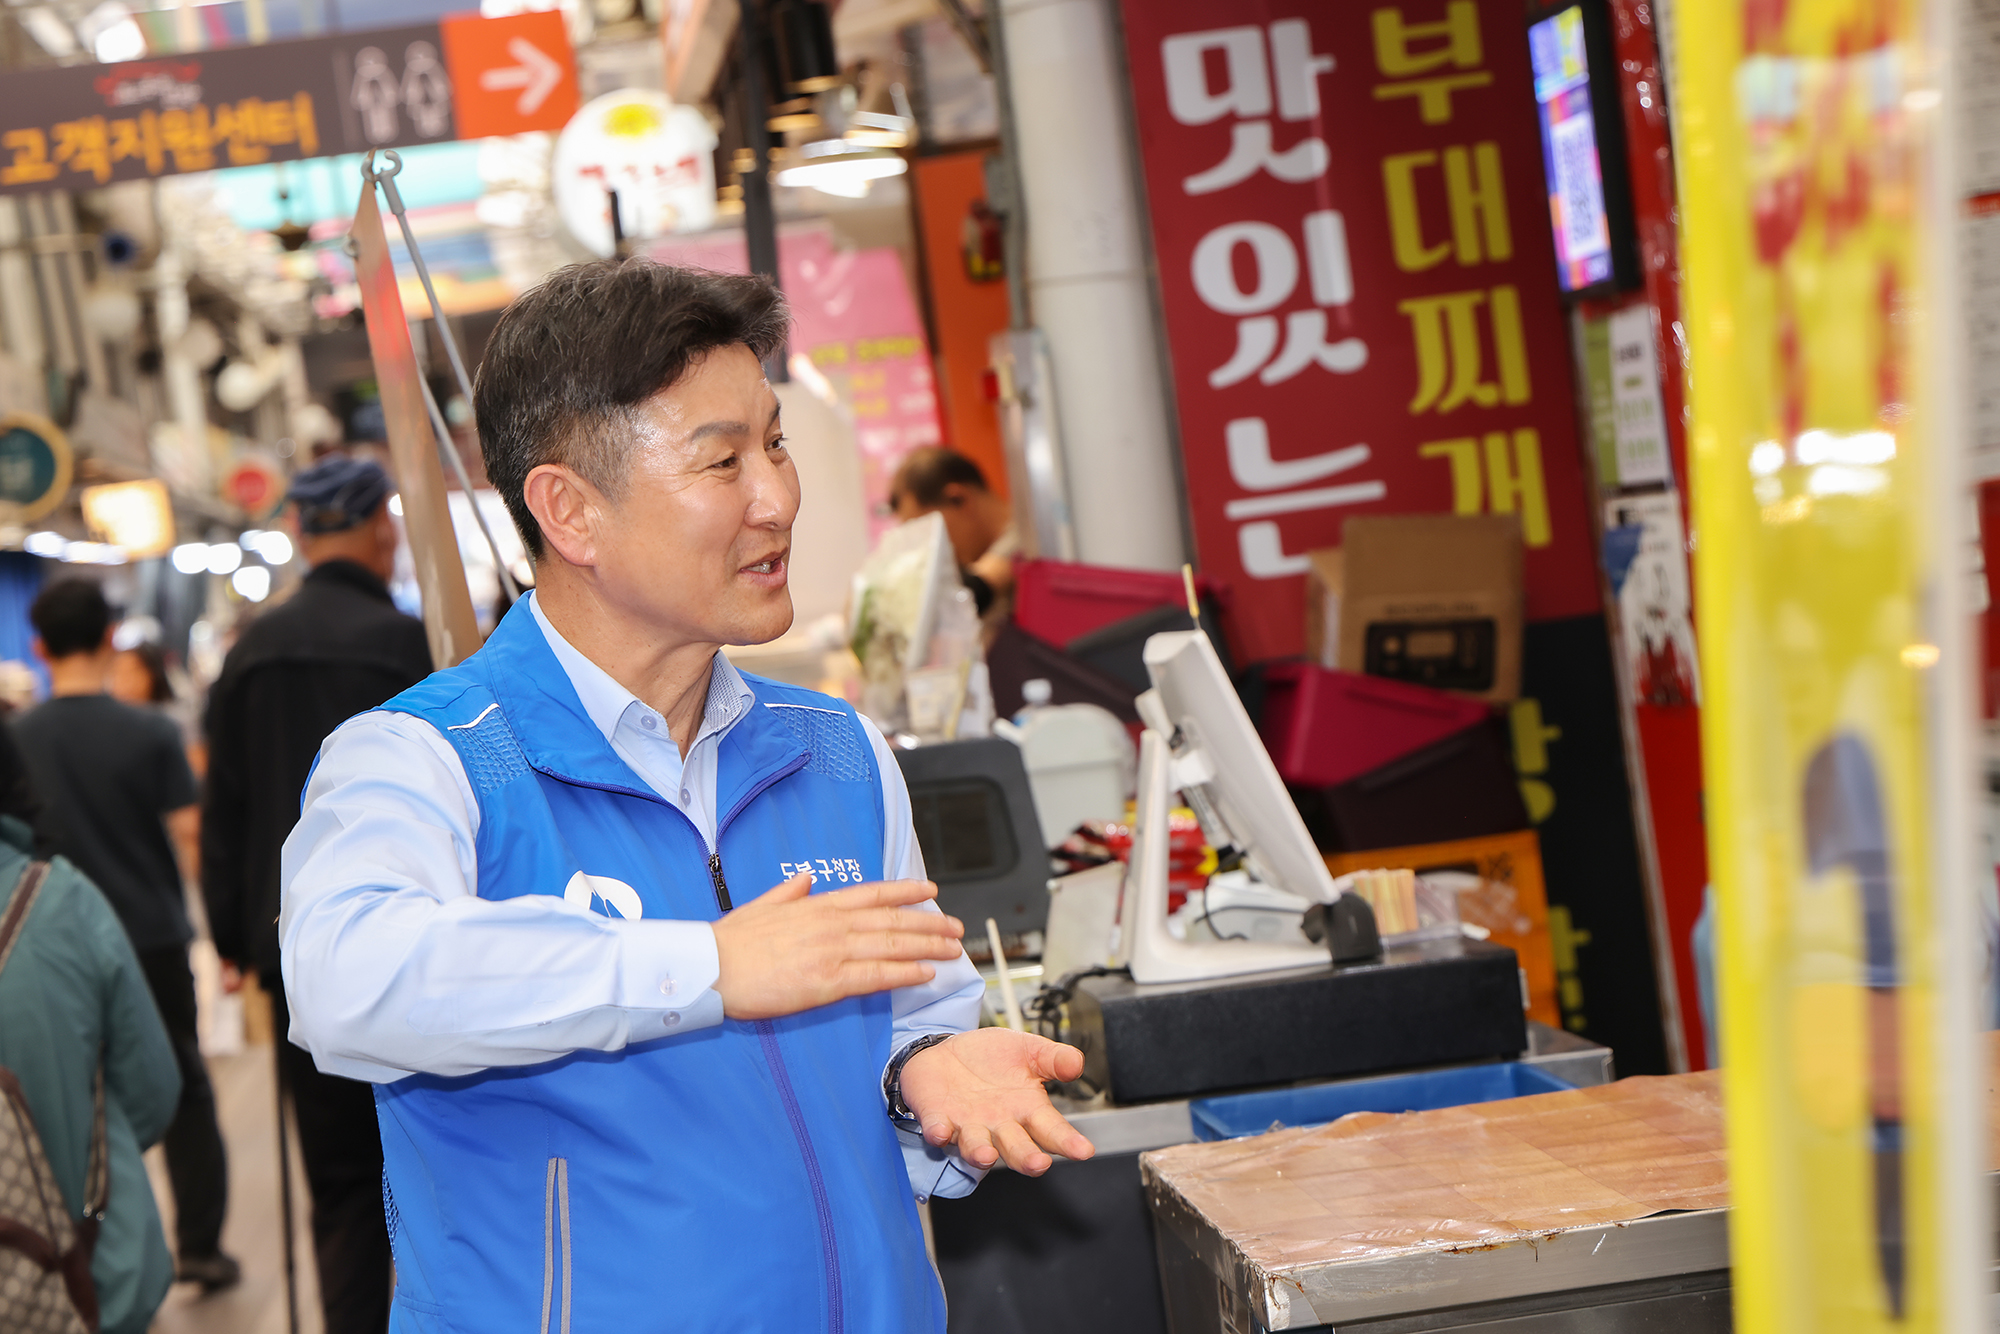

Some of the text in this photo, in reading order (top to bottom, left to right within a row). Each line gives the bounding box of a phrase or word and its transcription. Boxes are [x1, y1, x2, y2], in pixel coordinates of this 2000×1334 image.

[1, 91, 319, 186] 고객지원센터
[1161, 17, 1387, 580] 맛있는
[1371, 0, 1552, 548] 부대찌개
